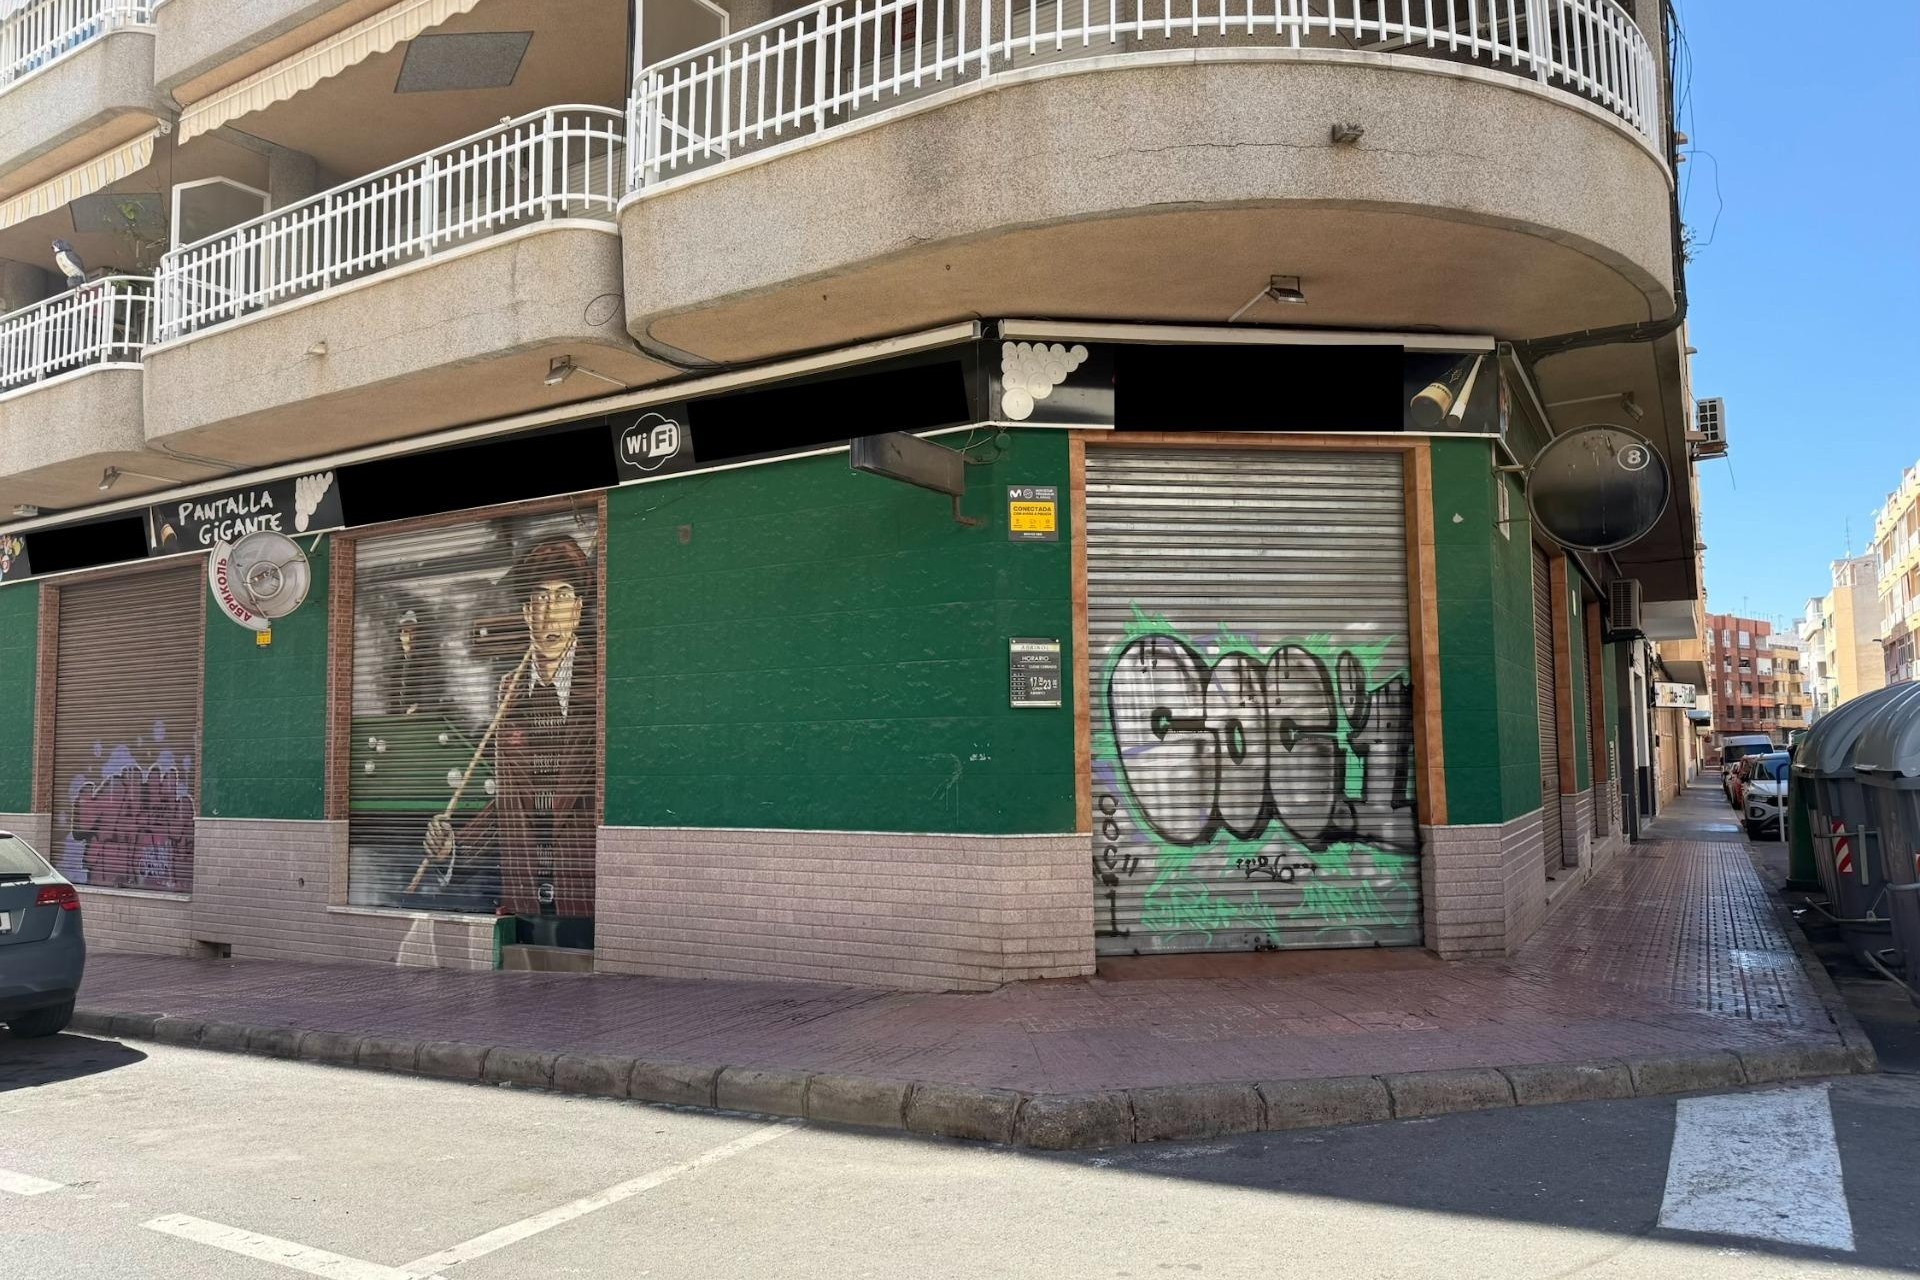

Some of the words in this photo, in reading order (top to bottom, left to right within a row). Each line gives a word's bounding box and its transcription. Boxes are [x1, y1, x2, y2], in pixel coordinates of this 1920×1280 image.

[1627, 449, 1642, 464] 8
[179, 490, 274, 526] PANTALLA
[217, 558, 253, 622] АБРИКОЛЬ
[1030, 676, 1038, 687] 17
[1043, 679, 1052, 690] 23
